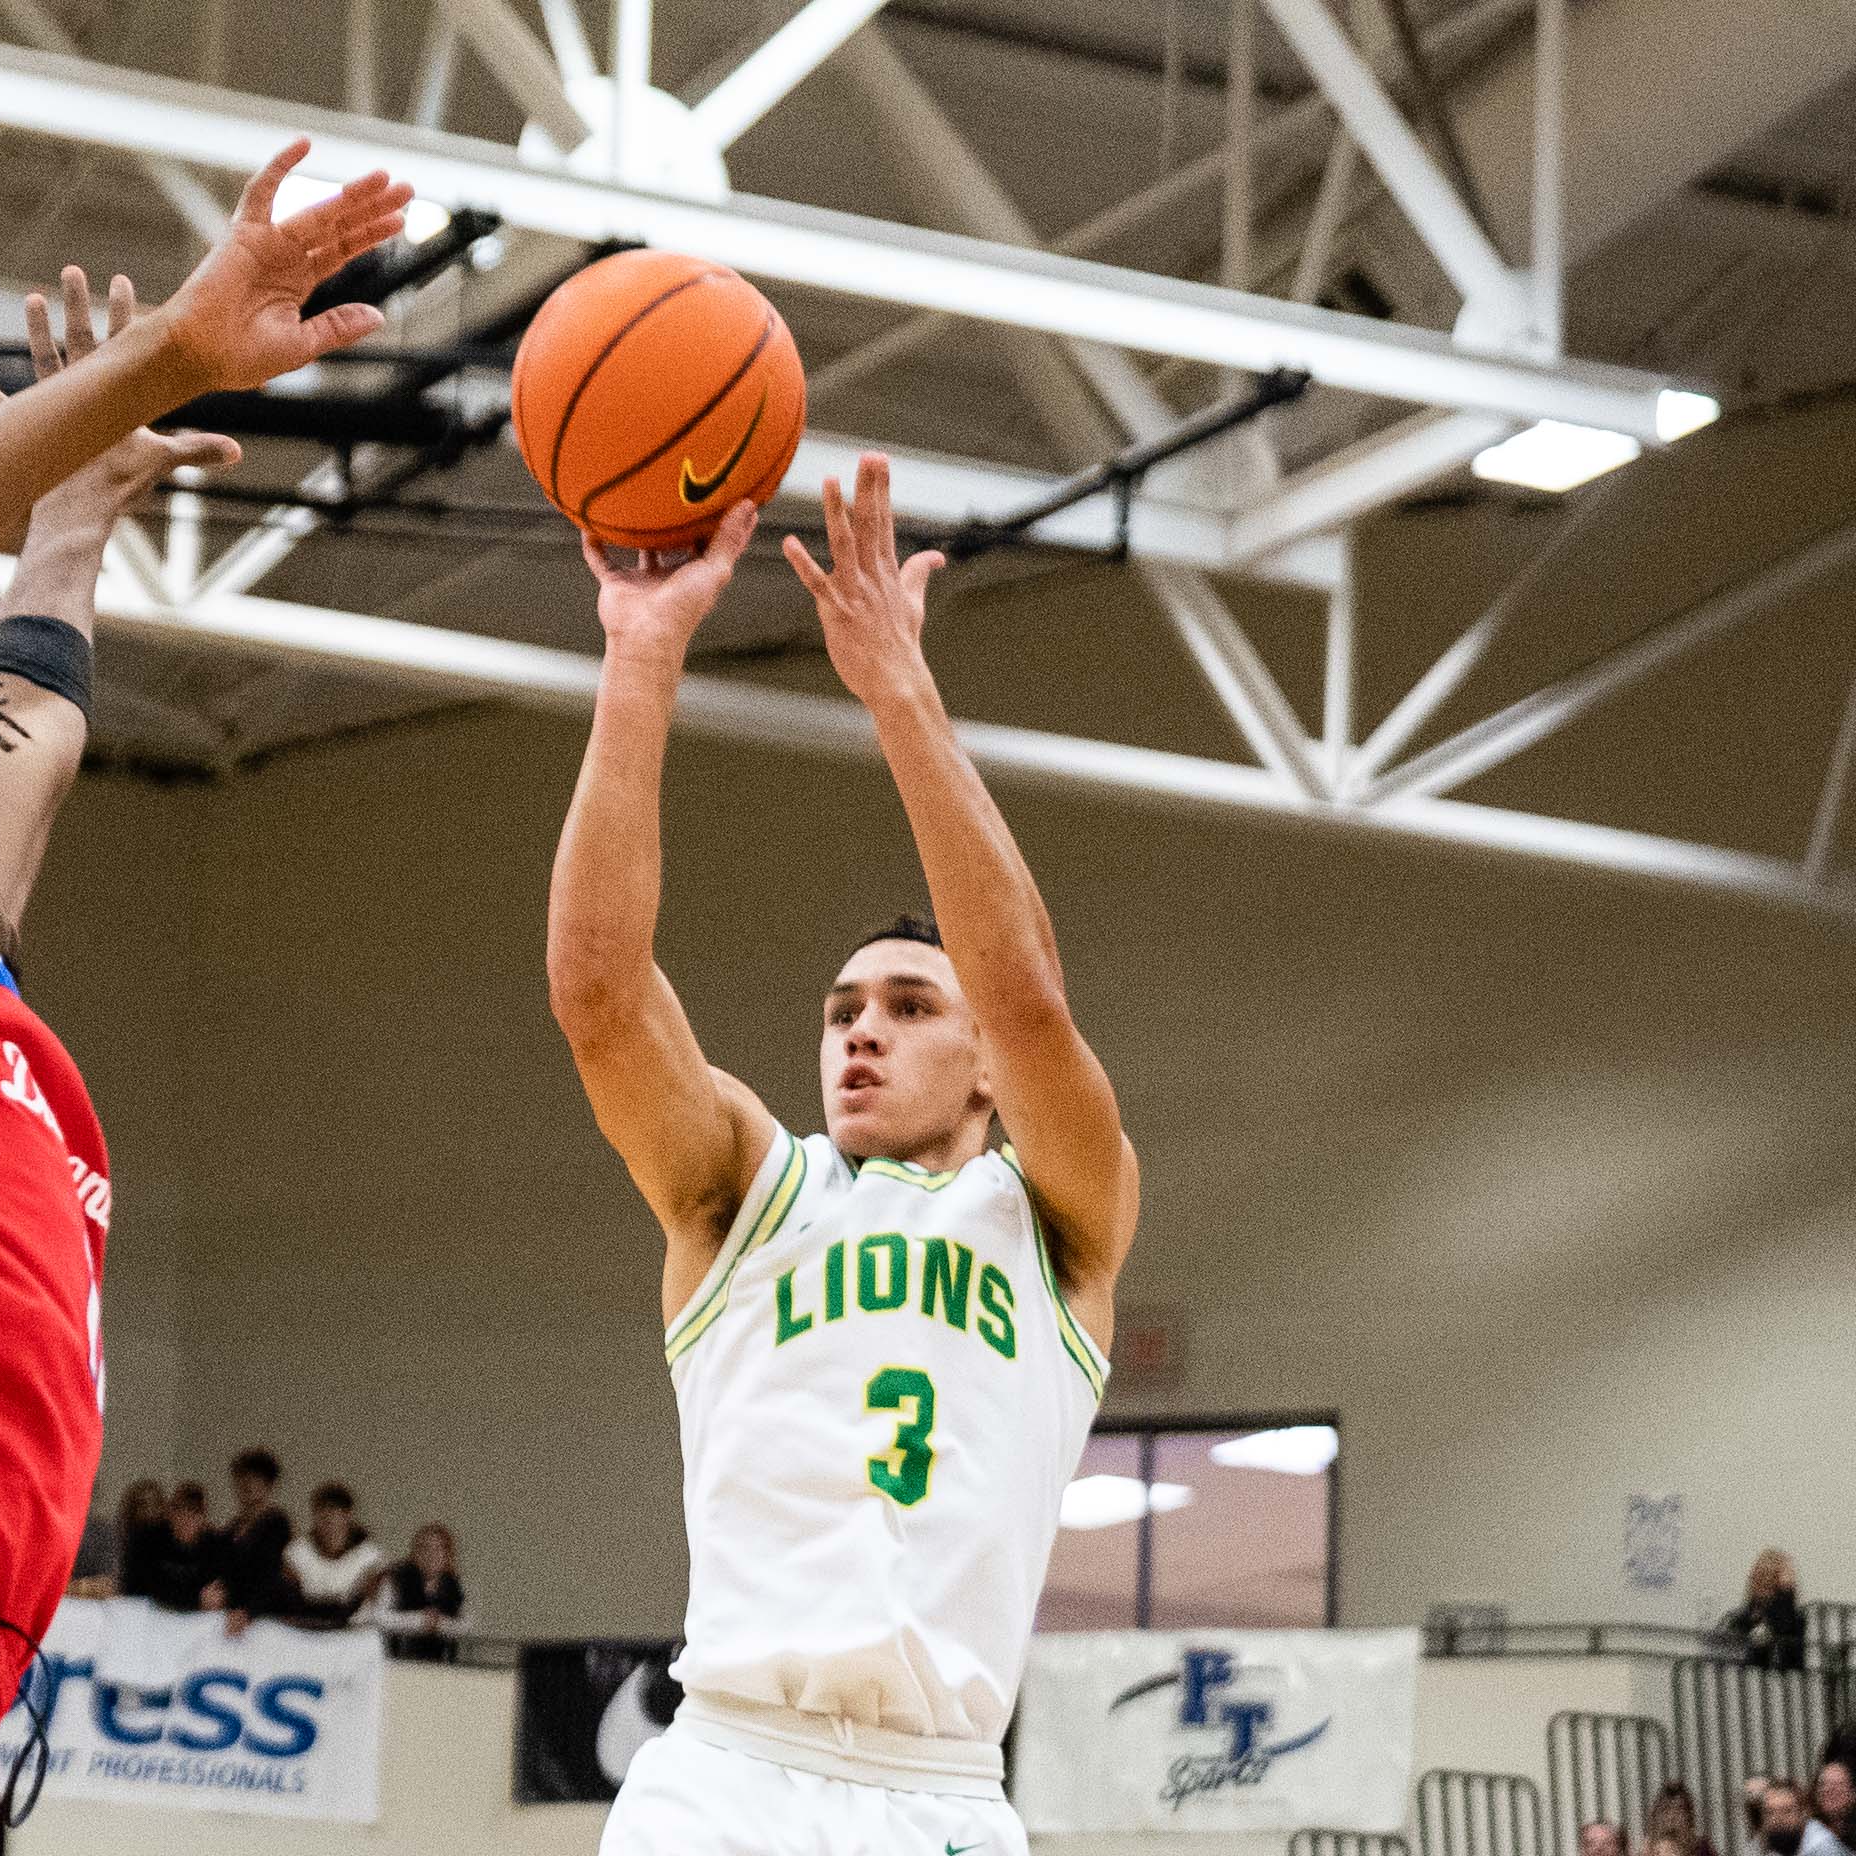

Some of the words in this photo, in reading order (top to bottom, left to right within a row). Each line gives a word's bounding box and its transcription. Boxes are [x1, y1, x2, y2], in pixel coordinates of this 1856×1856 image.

[775, 1231, 1017, 1361] LIONS
[863, 1363, 937, 1510] 3
[14, 1652, 324, 1758] ress
[87, 1751, 306, 1794] PROFESSIONALS
